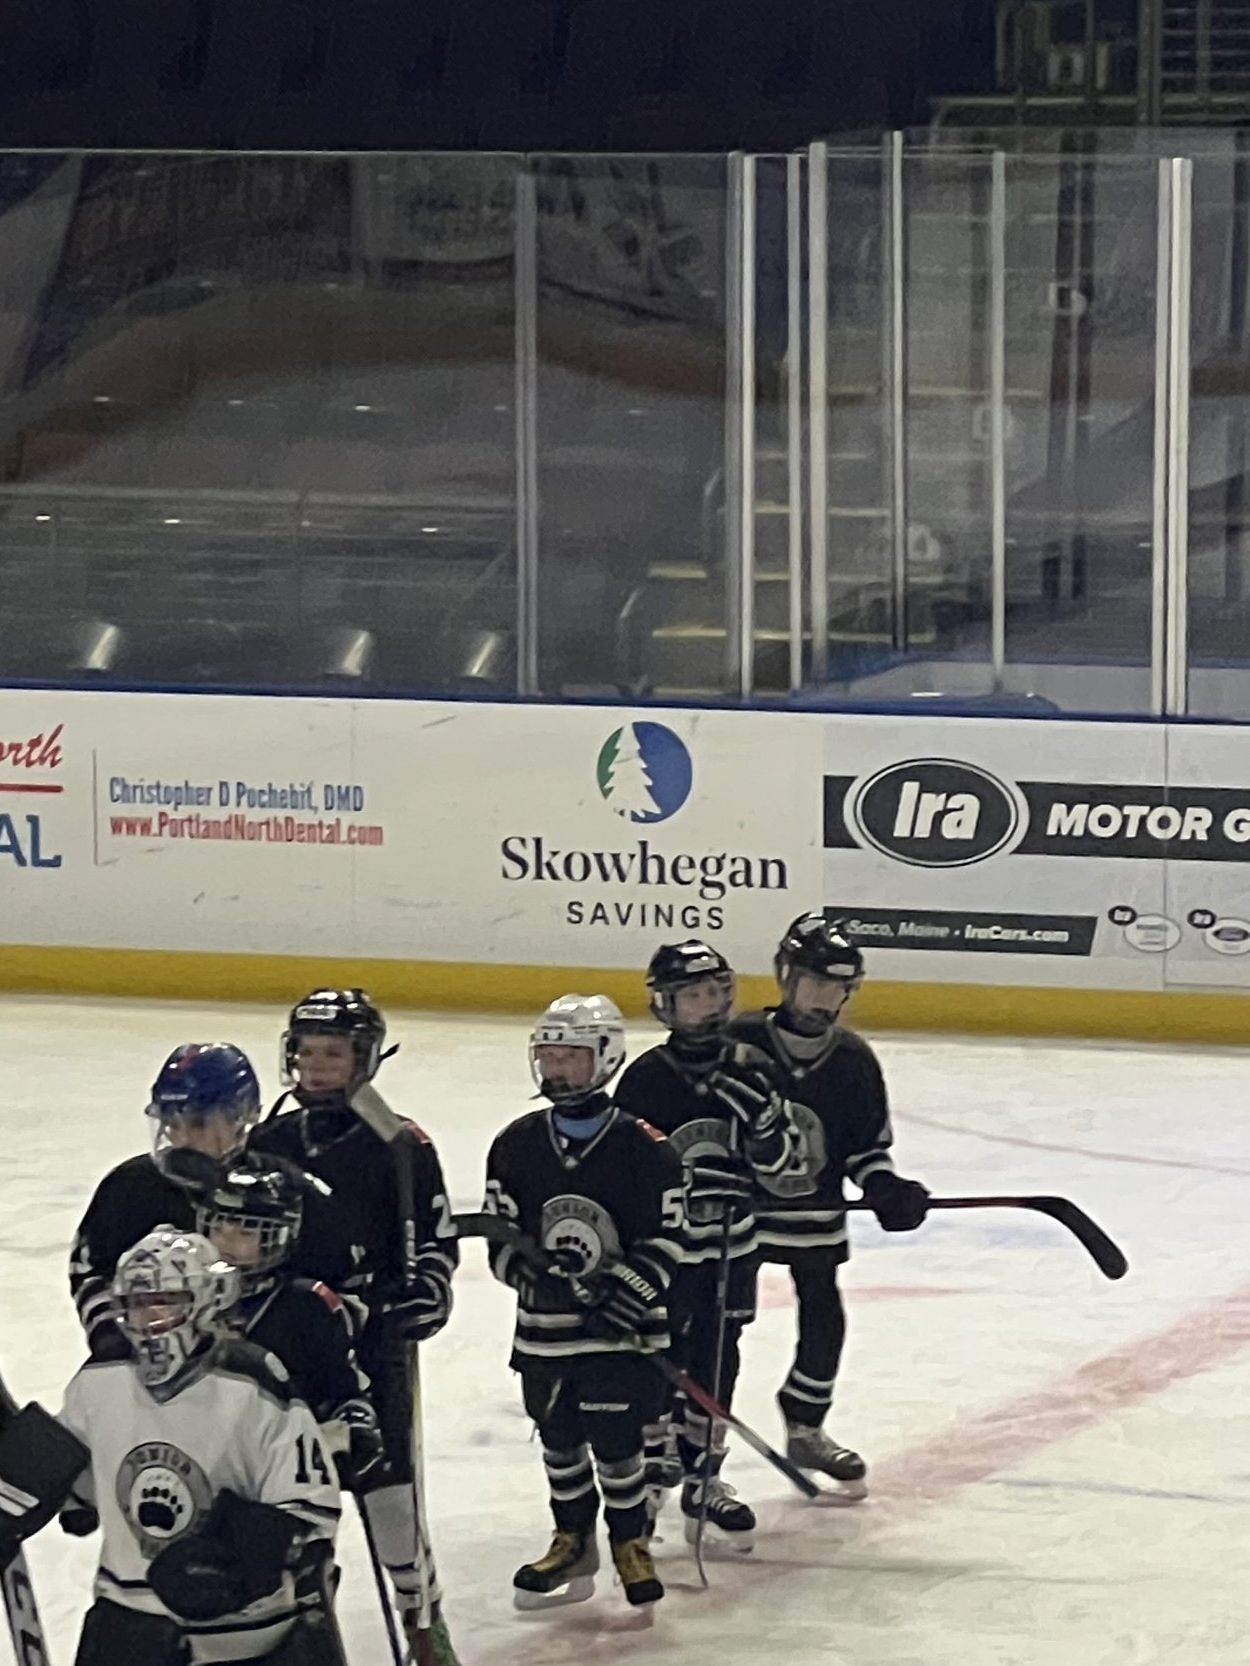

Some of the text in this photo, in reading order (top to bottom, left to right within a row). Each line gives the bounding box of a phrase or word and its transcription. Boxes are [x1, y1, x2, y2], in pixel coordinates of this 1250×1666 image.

[109, 776, 213, 812] Christopher
[218, 780, 231, 807] D
[323, 784, 365, 812] DMD
[892, 780, 981, 840] Ira
[1046, 802, 1214, 841] MOTOR
[110, 810, 384, 846] www.PortlandNorthDental.com
[501, 835, 789, 901] Skowhegan
[566, 900, 725, 931] SAVINGS
